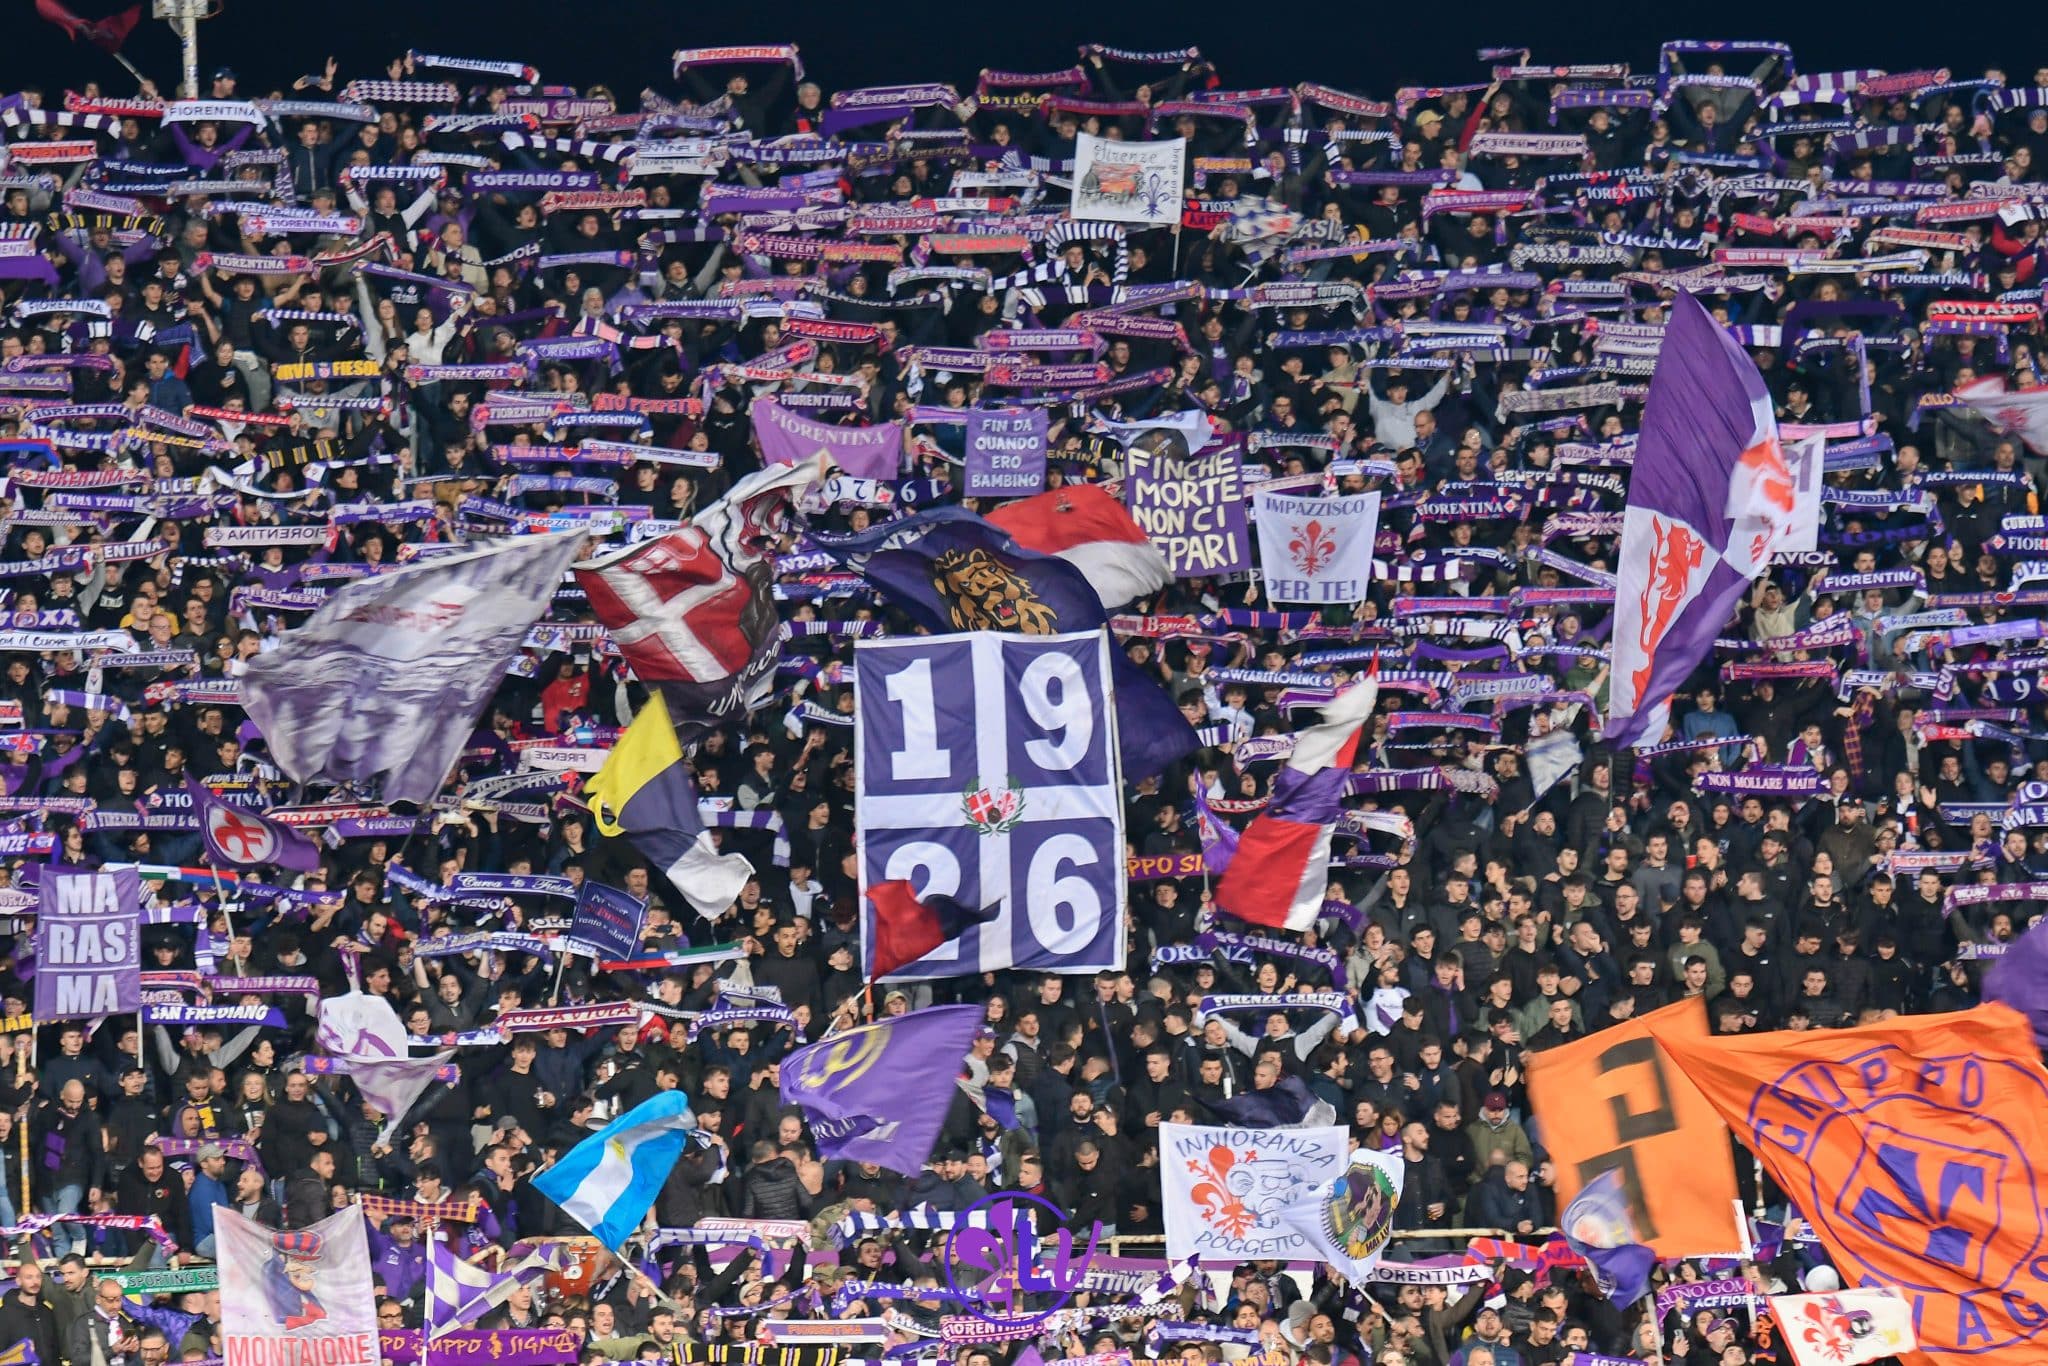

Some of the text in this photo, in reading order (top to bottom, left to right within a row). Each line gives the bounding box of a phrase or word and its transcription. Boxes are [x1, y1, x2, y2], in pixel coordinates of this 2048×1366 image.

[170, 107, 257, 118] FIORENTINA
[762, 147, 848, 160] LA MERDA
[349, 166, 441, 179] COLLETTIVO
[472, 172, 591, 187] SOFFIANO 95
[271, 219, 339, 230] FIORENTINA
[213, 256, 285, 270] FIORENTINA
[1892, 268, 1970, 284] FIORENTINA
[28, 301, 104, 313] FIORENTINA
[791, 321, 876, 337] FIORENTINA
[1081, 313, 1175, 333] Forza Fiorentina
[1009, 333, 1079, 346] FIORENTINA
[476, 368, 504, 378] VIOLA
[23, 376, 63, 387] VIOLA
[293, 396, 384, 410] COLLETTIVO
[781, 394, 852, 408] FIORENTINA
[489, 405, 552, 419] FIORENTINA
[558, 414, 643, 426] ACF FIORENTINA
[770, 408, 886, 445] FIORENTINA
[982, 418, 1033, 432] FIN DA
[974, 436, 1039, 451] QUANDO
[991, 456, 1022, 470] ERO
[971, 473, 1041, 489] BAMBINO
[1926, 471, 1947, 483] ACF
[1134, 475, 1243, 510] MORTE
[1265, 496, 1365, 516] IMPAZZISCO
[1416, 501, 1503, 516] FIORENTINA
[22, 511, 81, 522] FIORENTINA
[1132, 505, 1226, 536] NON CI
[2001, 515, 2044, 530] CURVA
[1150, 532, 1239, 573] EPARI
[1824, 571, 1917, 588] FIORENTINA
[1317, 578, 1358, 601] TE!
[98, 653, 193, 667] FIORENTINA
[1302, 652, 1323, 666] ACF
[884, 657, 952, 781] 1
[1018, 651, 1094, 771] 9
[1708, 773, 1732, 788] NON
[1735, 774, 1787, 789] MOLLARE
[86, 815, 97, 828] DI
[99, 814, 141, 829] FIRENZE
[144, 814, 175, 828] VANTO
[458, 875, 504, 889] Curva
[56, 873, 120, 914] MA
[1026, 832, 1102, 956] 6
[48, 922, 126, 964] RAS
[55, 973, 119, 1015] MA
[1213, 993, 1342, 1009] FIRENZE CARICA
[150, 1005, 181, 1020] SAN
[697, 1008, 795, 1025] FIORENTINA
[1193, 1229, 1307, 1256] POGGETTO
[128, 1271, 195, 1288] SPORTING
[1694, 1297, 1720, 1309] ACF
[228, 1333, 372, 1366] MONTAIONE
